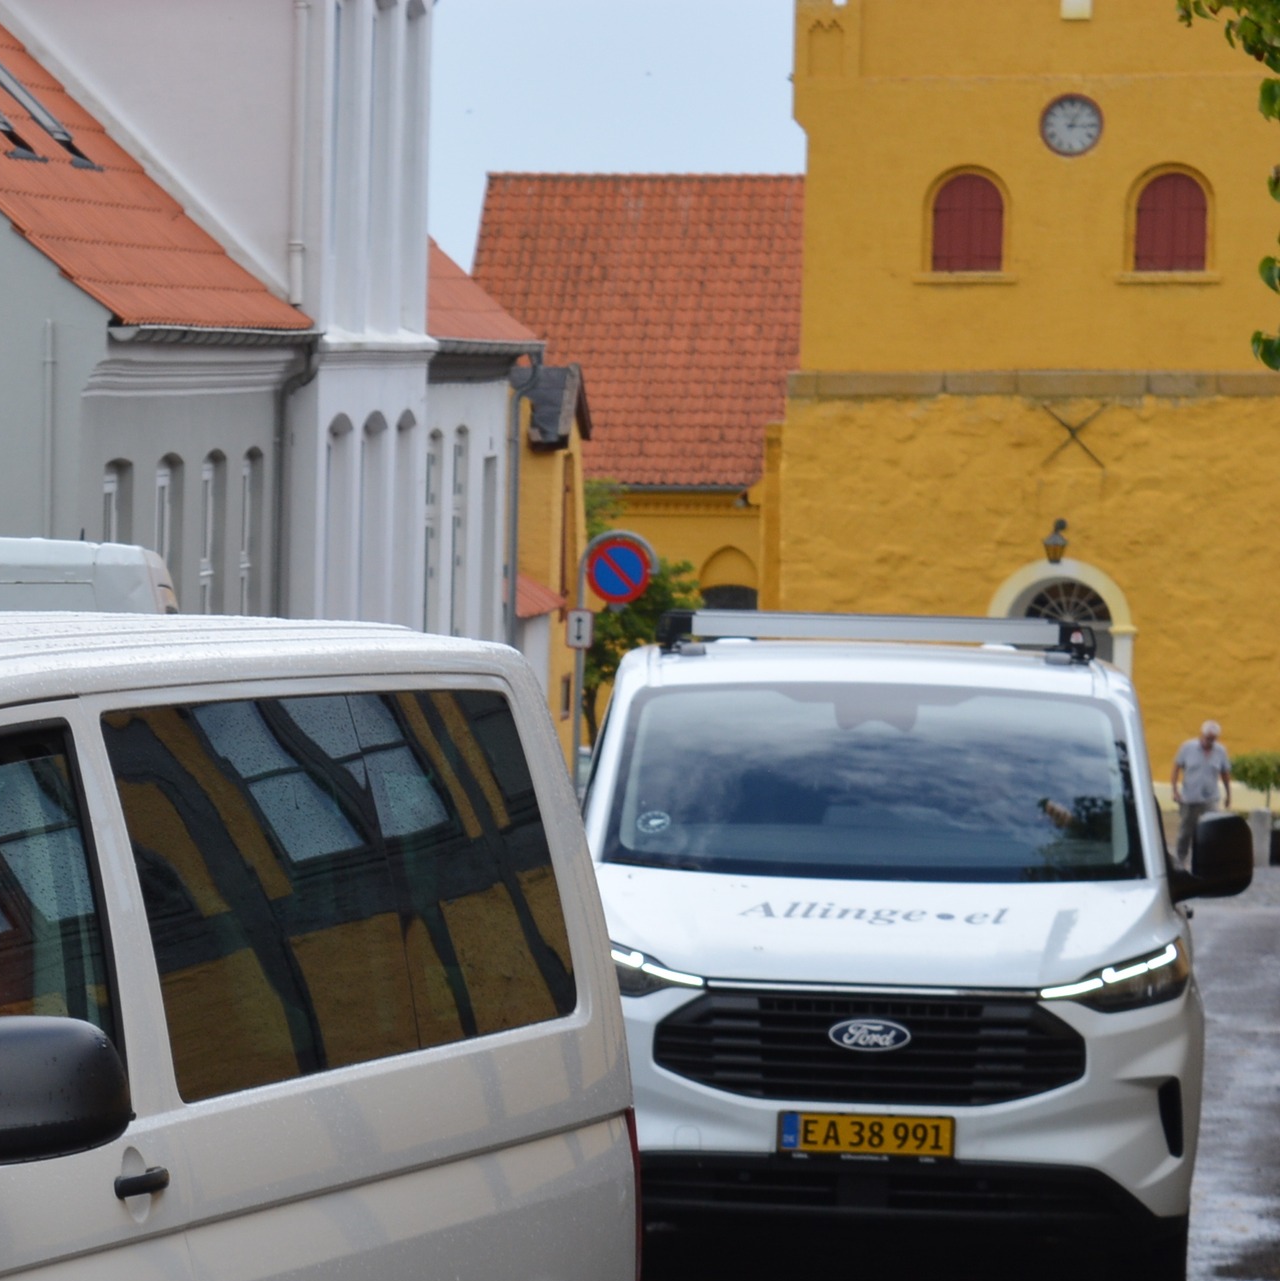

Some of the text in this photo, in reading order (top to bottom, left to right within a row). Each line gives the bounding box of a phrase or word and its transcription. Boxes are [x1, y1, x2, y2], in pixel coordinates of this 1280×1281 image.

[802, 1119, 841, 1146] EA
[848, 1121, 885, 1148] 38
[893, 1122, 943, 1150] 991
